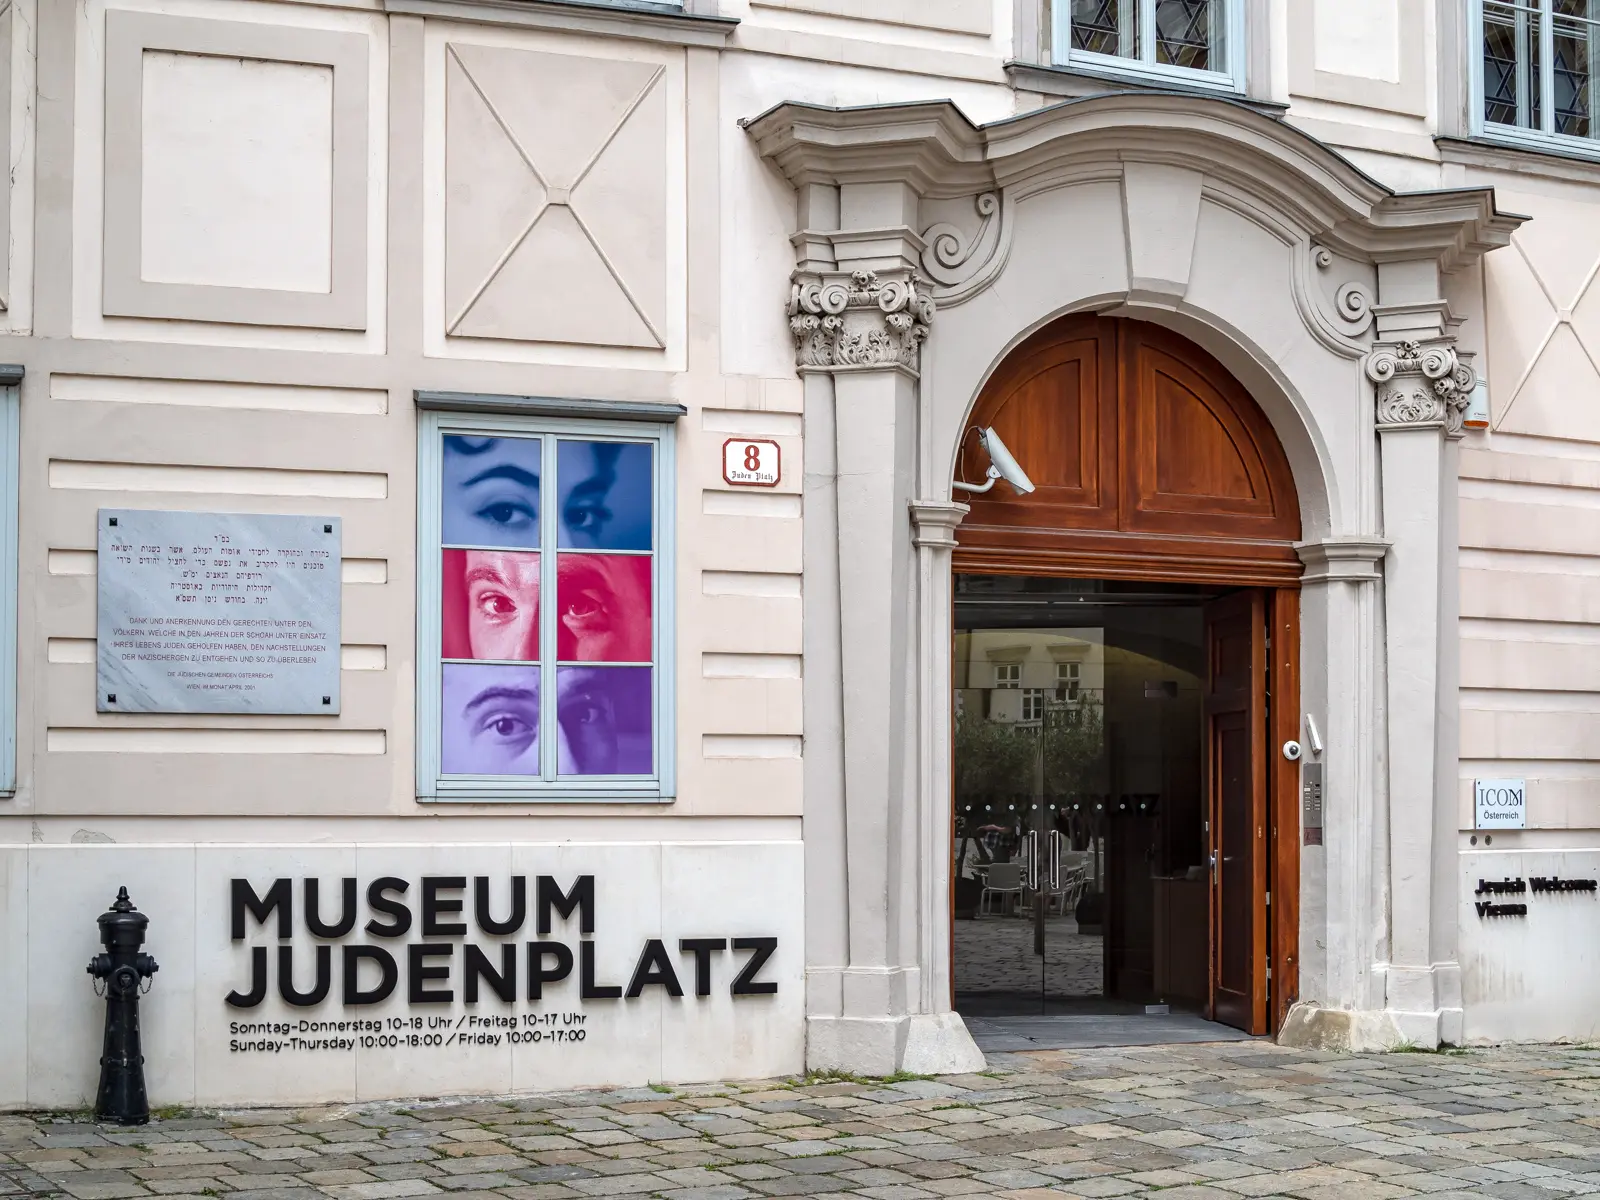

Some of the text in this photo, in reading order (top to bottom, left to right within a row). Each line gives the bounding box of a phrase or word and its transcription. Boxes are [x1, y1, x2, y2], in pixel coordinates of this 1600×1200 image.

[744, 445, 760, 471] 8
[732, 471, 773, 482] Juden Platz
[169, 546, 183, 554] אשר
[233, 619, 272, 627] GERECHTEN
[300, 632, 326, 640] EINSATZ
[266, 644, 326, 652] NACHSTELLUNGEN
[138, 654, 189, 662] NAZISCHERGEN
[1479, 788, 1522, 806] ICOM
[1484, 810, 1519, 820] Österreich
[231, 874, 595, 940] MUSEUM
[224, 936, 779, 1009] JUDENPLATZ
[229, 1017, 382, 1035] Sonntag-Donnerstag
[386, 1016, 424, 1031] 10-18
[427, 1016, 452, 1030] Uhr
[469, 1014, 517, 1031] Freitag
[523, 1014, 558, 1027] 10-17
[562, 1012, 587, 1026] Uhr
[229, 1036, 356, 1054] Sunday-Thursday
[359, 1033, 442, 1048] 10:00-18:00
[459, 1032, 503, 1047] Friday
[506, 1029, 586, 1045] 10:00-17:00
